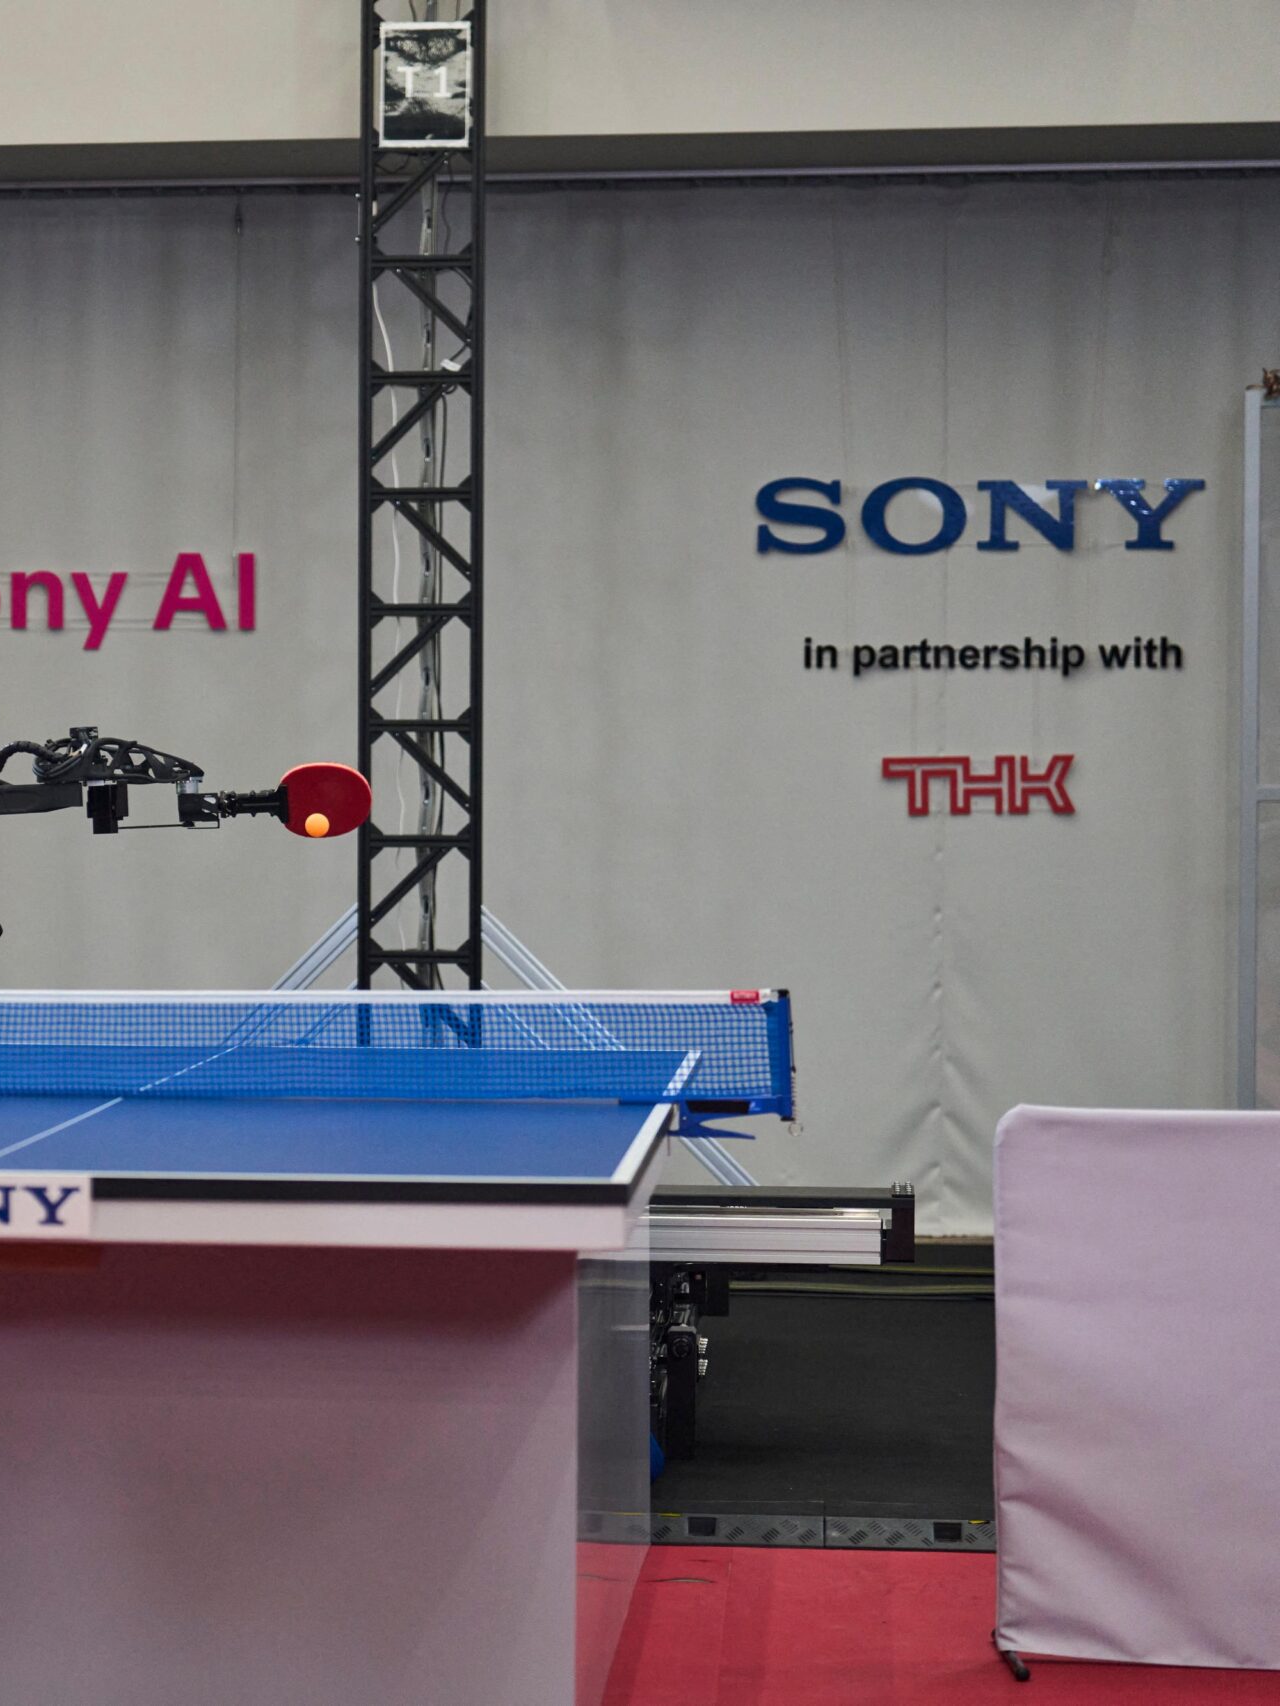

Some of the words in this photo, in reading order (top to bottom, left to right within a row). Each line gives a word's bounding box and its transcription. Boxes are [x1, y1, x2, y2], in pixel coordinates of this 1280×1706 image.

[754, 476, 1206, 557] SONY
[153, 552, 256, 631] AI
[803, 636, 839, 670] in
[852, 636, 1087, 679] partnership
[1097, 635, 1184, 671] with
[882, 755, 1076, 816] THK
